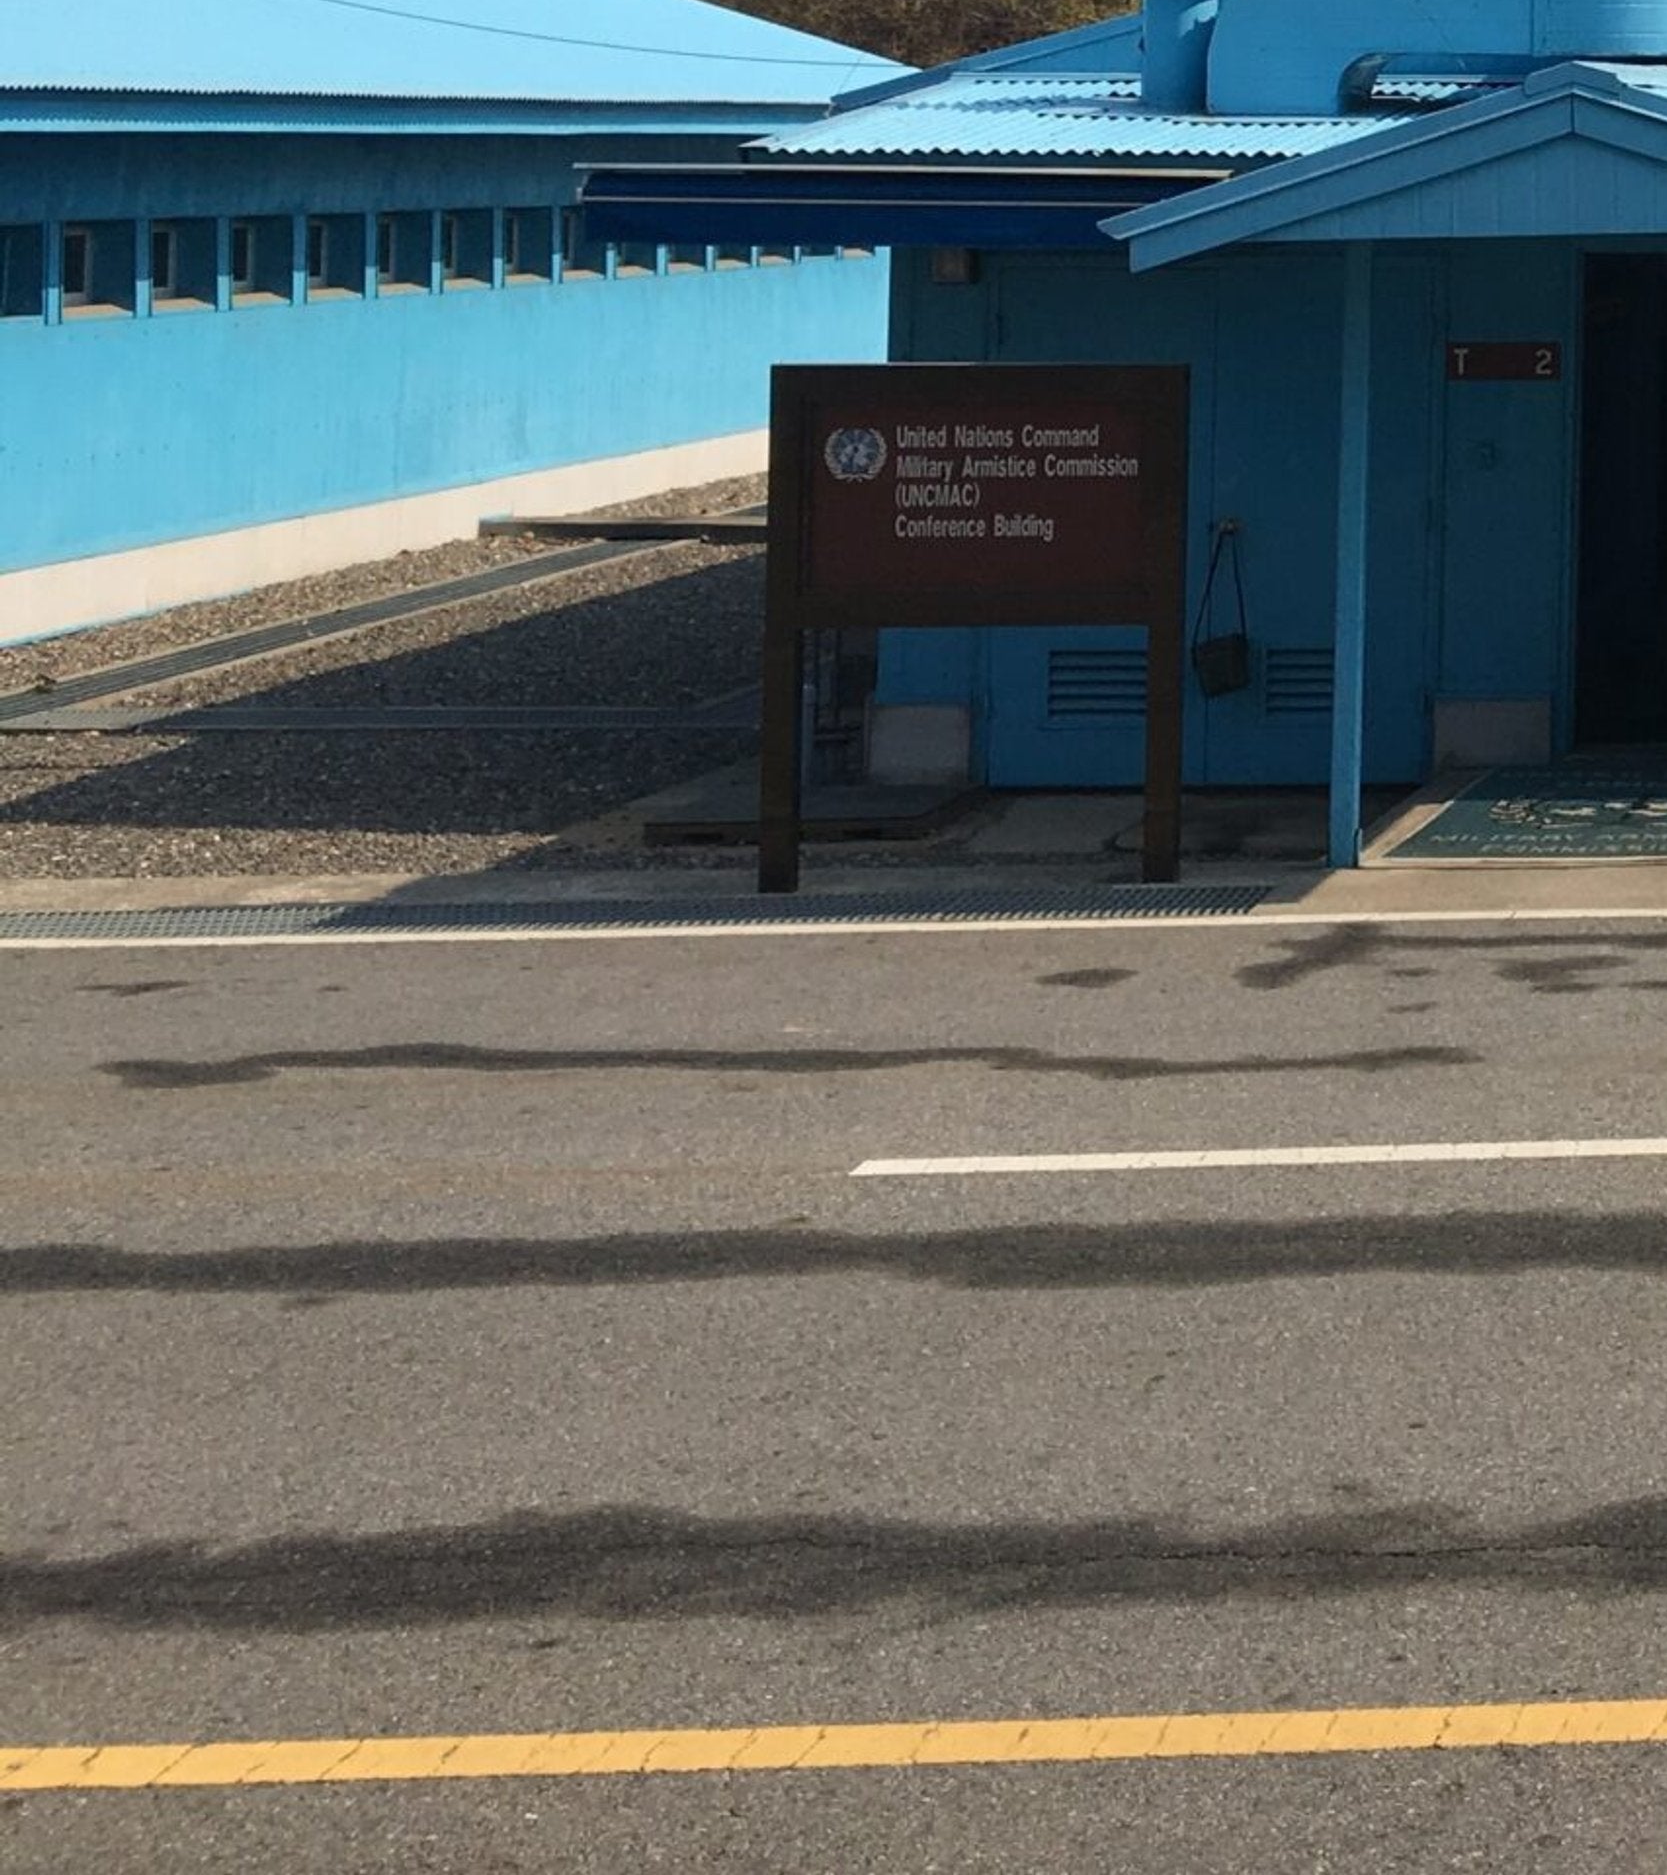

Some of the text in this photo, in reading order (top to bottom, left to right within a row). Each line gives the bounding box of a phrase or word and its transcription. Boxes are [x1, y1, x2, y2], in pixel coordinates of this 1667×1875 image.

[1453, 348, 1552, 375] T 2
[896, 425, 1100, 448] United Nations Command
[896, 454, 1138, 482] Military Armistice Commission
[895, 483, 980, 507] (UNCMAC)
[895, 514, 1055, 542] Conference Building
